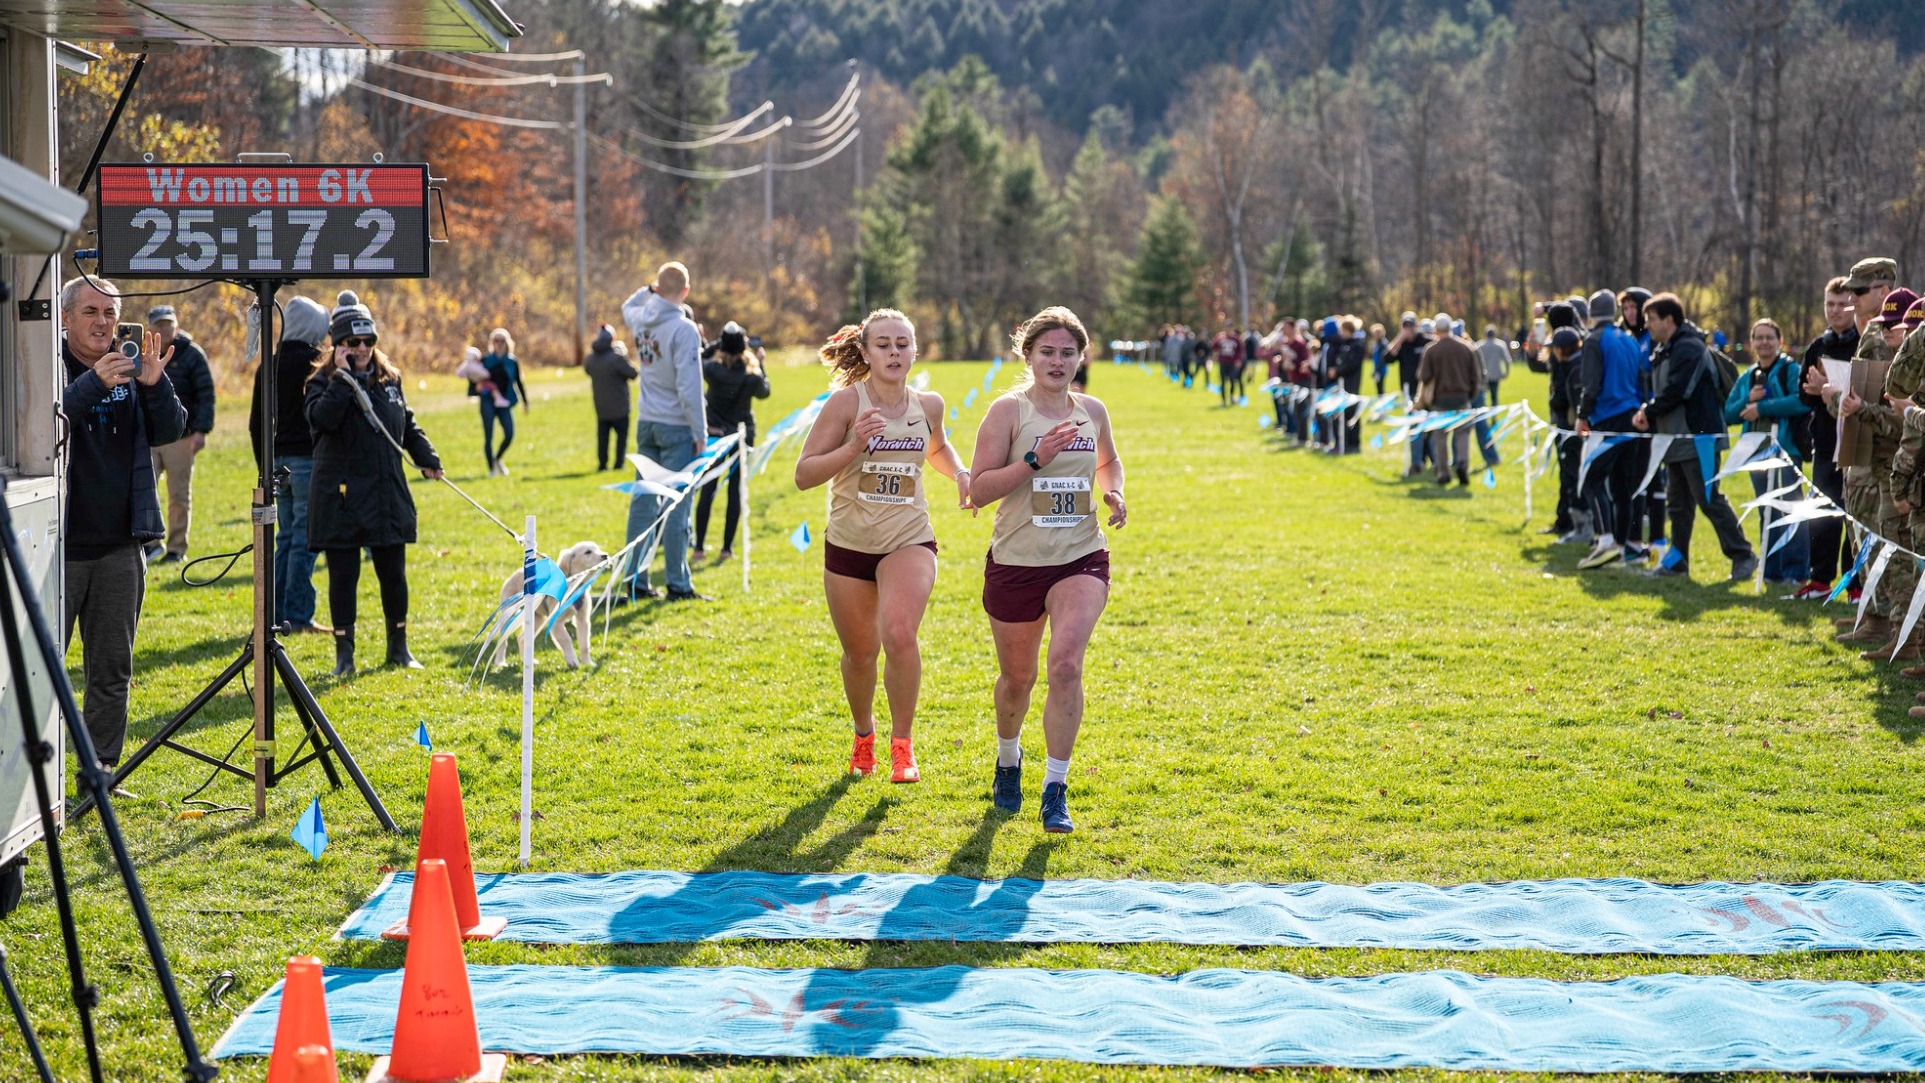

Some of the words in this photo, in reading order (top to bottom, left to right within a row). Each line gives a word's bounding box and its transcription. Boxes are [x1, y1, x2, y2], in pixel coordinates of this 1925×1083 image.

[146, 168, 299, 203] Women
[317, 169, 374, 203] 6K
[129, 208, 396, 271] 25:17.2
[863, 435, 925, 456] Norwich
[876, 474, 901, 495] 36
[866, 495, 906, 503] CHAMPIONSHIPS
[1051, 492, 1076, 515] 38
